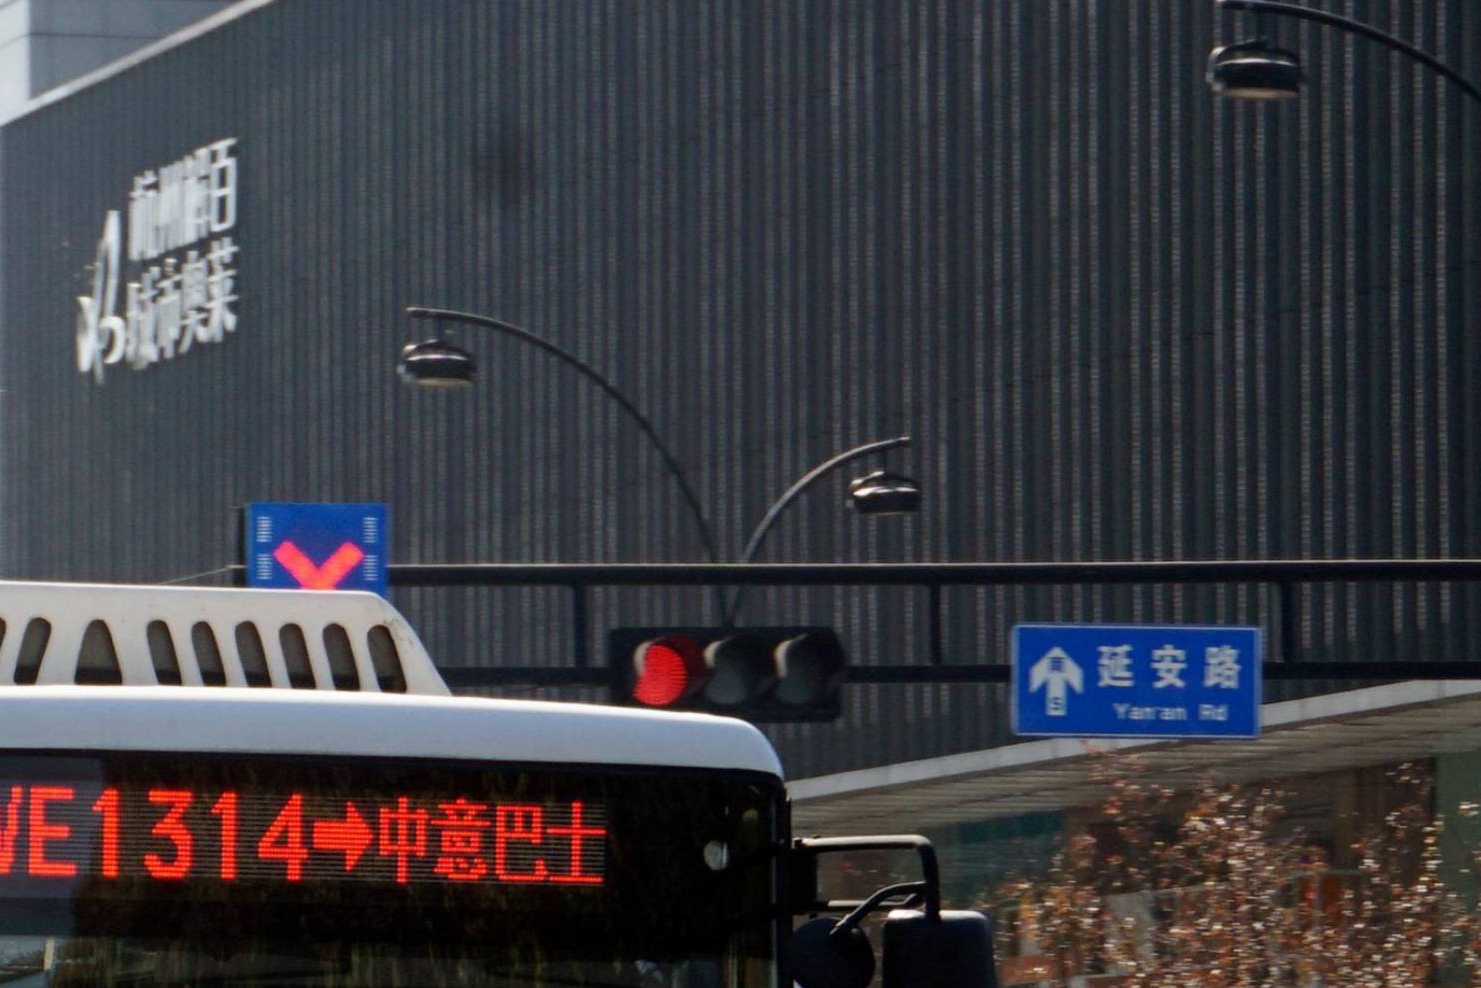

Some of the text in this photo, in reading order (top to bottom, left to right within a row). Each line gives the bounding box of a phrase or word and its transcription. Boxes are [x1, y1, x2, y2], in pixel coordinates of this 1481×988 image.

[1096, 644, 1242, 690] 延安路
[1198, 703, 1229, 722] Rd
[378, 796, 607, 884] 中意巴士
